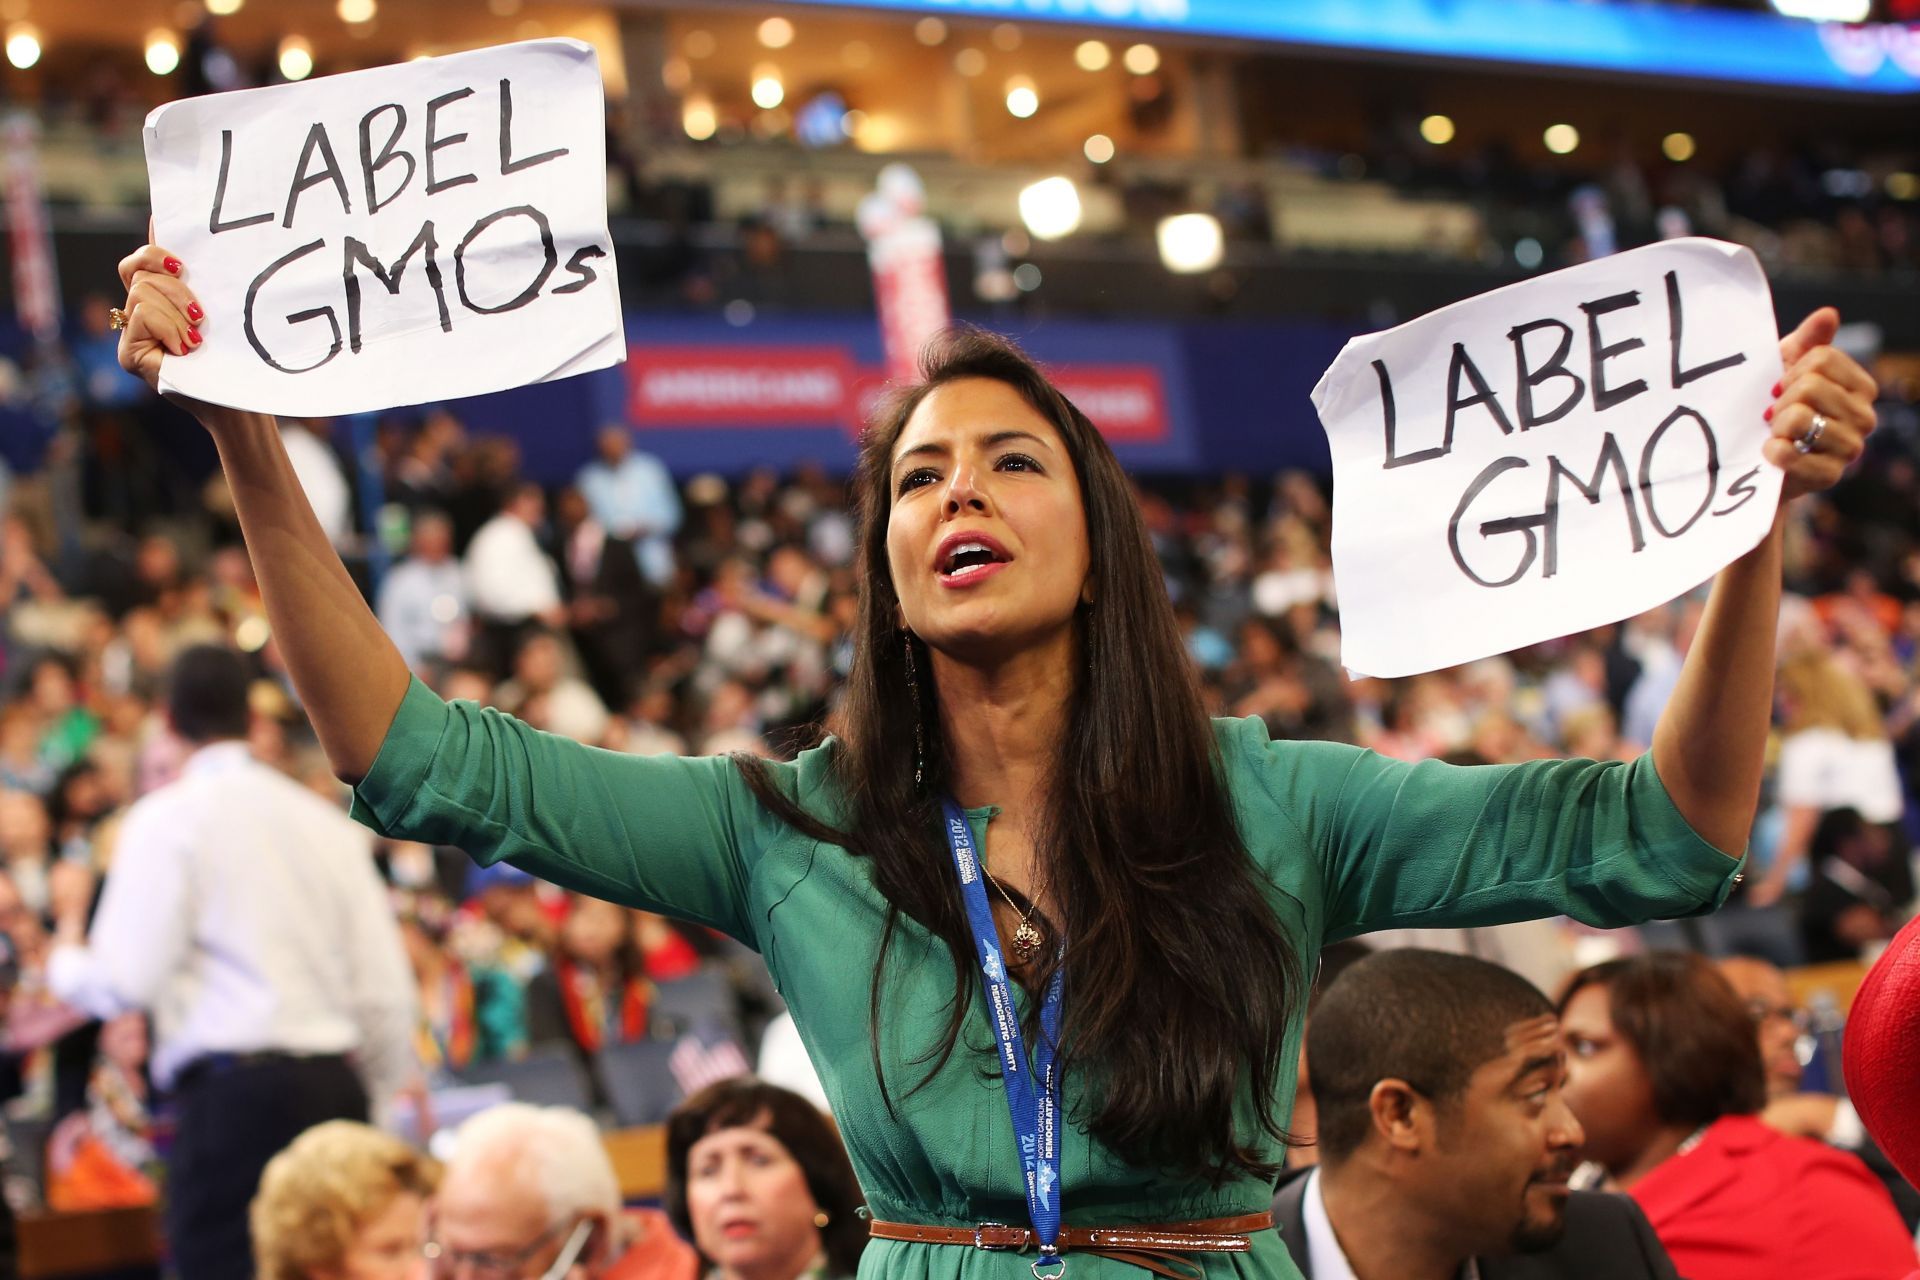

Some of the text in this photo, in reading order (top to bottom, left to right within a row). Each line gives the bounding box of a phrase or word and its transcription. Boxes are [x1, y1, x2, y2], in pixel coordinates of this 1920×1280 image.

[210, 79, 569, 234] LABEL
[244, 205, 606, 374] GMOs
[1371, 270, 1746, 469] LABEL
[1448, 405, 1761, 588] GMOs
[950, 819, 969, 847] 2012
[960, 848, 973, 883] NATIONAL
[991, 984, 1016, 1071] DEMOCRATIC PARTY
[1000, 983, 1017, 1038] NORTH CAROLINA
[1021, 1133, 1035, 1170] 2012
[1045, 1097, 1053, 1159] DEMOCRATIC
